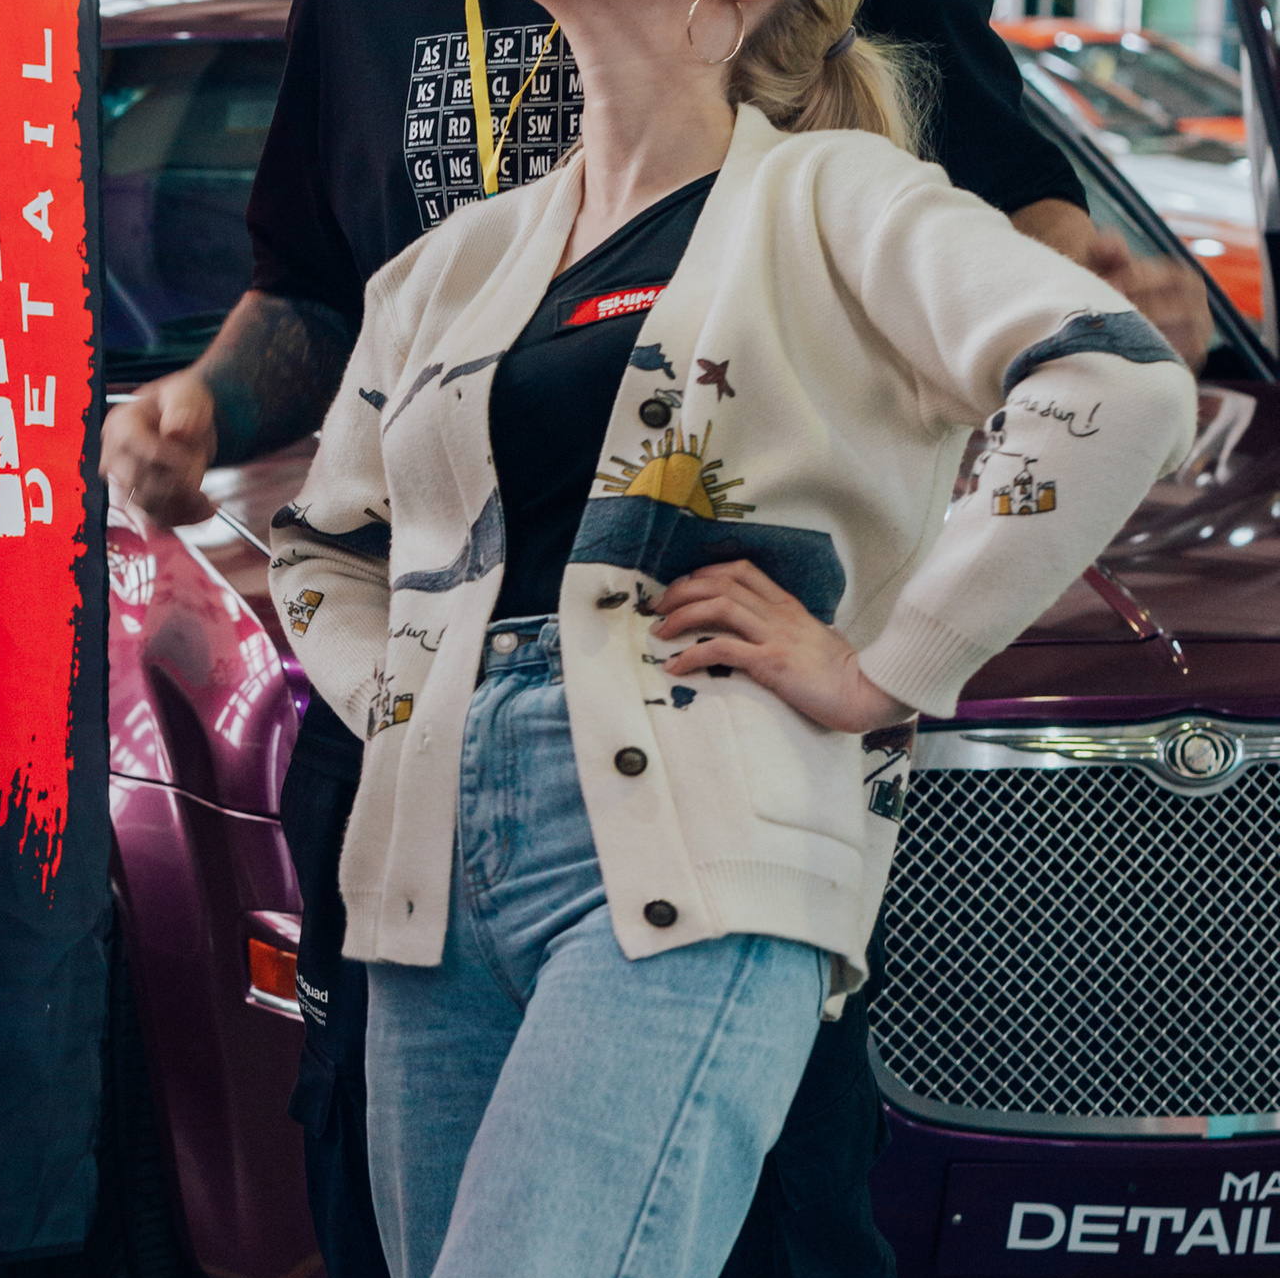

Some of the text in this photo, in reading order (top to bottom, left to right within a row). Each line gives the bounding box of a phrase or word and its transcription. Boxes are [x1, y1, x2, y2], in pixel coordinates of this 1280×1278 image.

[421, 44, 441, 66] AS
[455, 41, 471, 62] U
[493, 37, 514, 58] SP
[531, 34, 552, 55] HS
[416, 82, 436, 103] KS
[452, 78, 471, 99] RE
[492, 76, 510, 97] CL
[531, 74, 551, 95] LU
[408, 118, 434, 141] BW
[448, 117, 471, 137] RD
[527, 115, 552, 136] SW
[414, 159, 434, 181] CG
[449, 156, 472, 178] NG
[529, 156, 551, 176] MU
[1005, 1201, 1280, 1256] DETAIL
